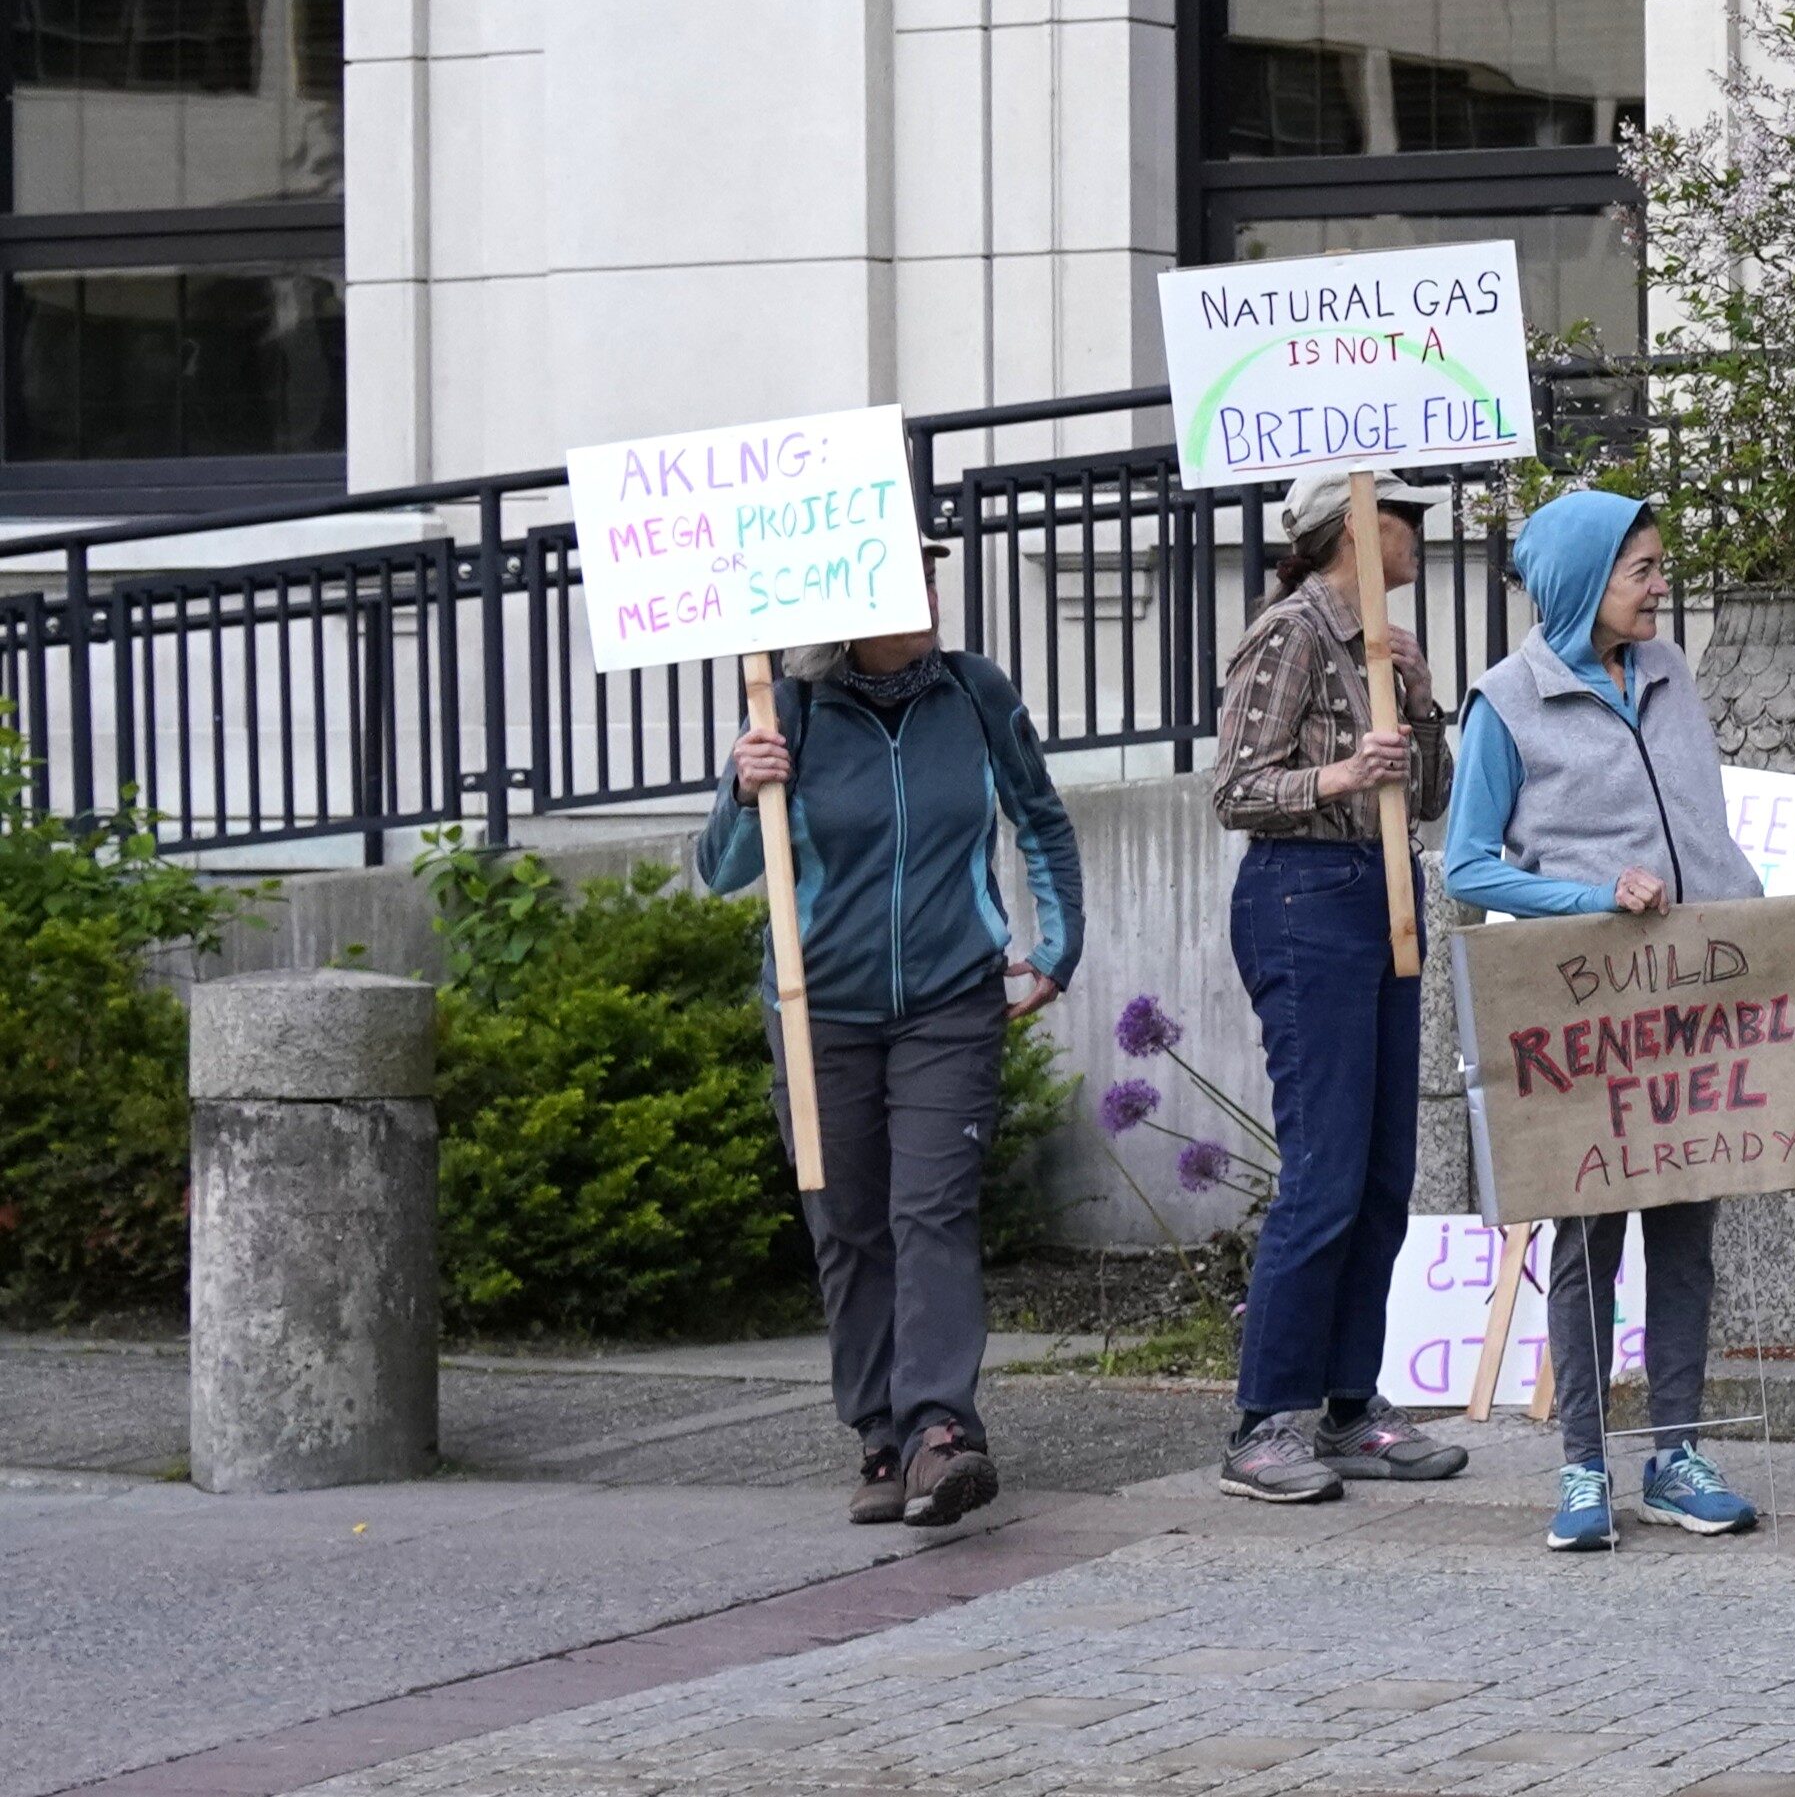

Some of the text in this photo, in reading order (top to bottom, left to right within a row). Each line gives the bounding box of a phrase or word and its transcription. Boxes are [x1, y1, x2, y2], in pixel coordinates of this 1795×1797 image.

[1201, 271, 1500, 329] NATURAL GAS
[1287, 327, 1445, 367] IS NOT A
[1220, 397, 1517, 465] BRIDGE FUEL
[608, 480, 896, 562] MEGA PROJECT
[618, 538, 887, 639] MEGA SCAM?
[711, 553, 748, 573] OR
[1555, 937, 1750, 1006] BUILD
[1605, 1058, 1768, 1139] FUEL
